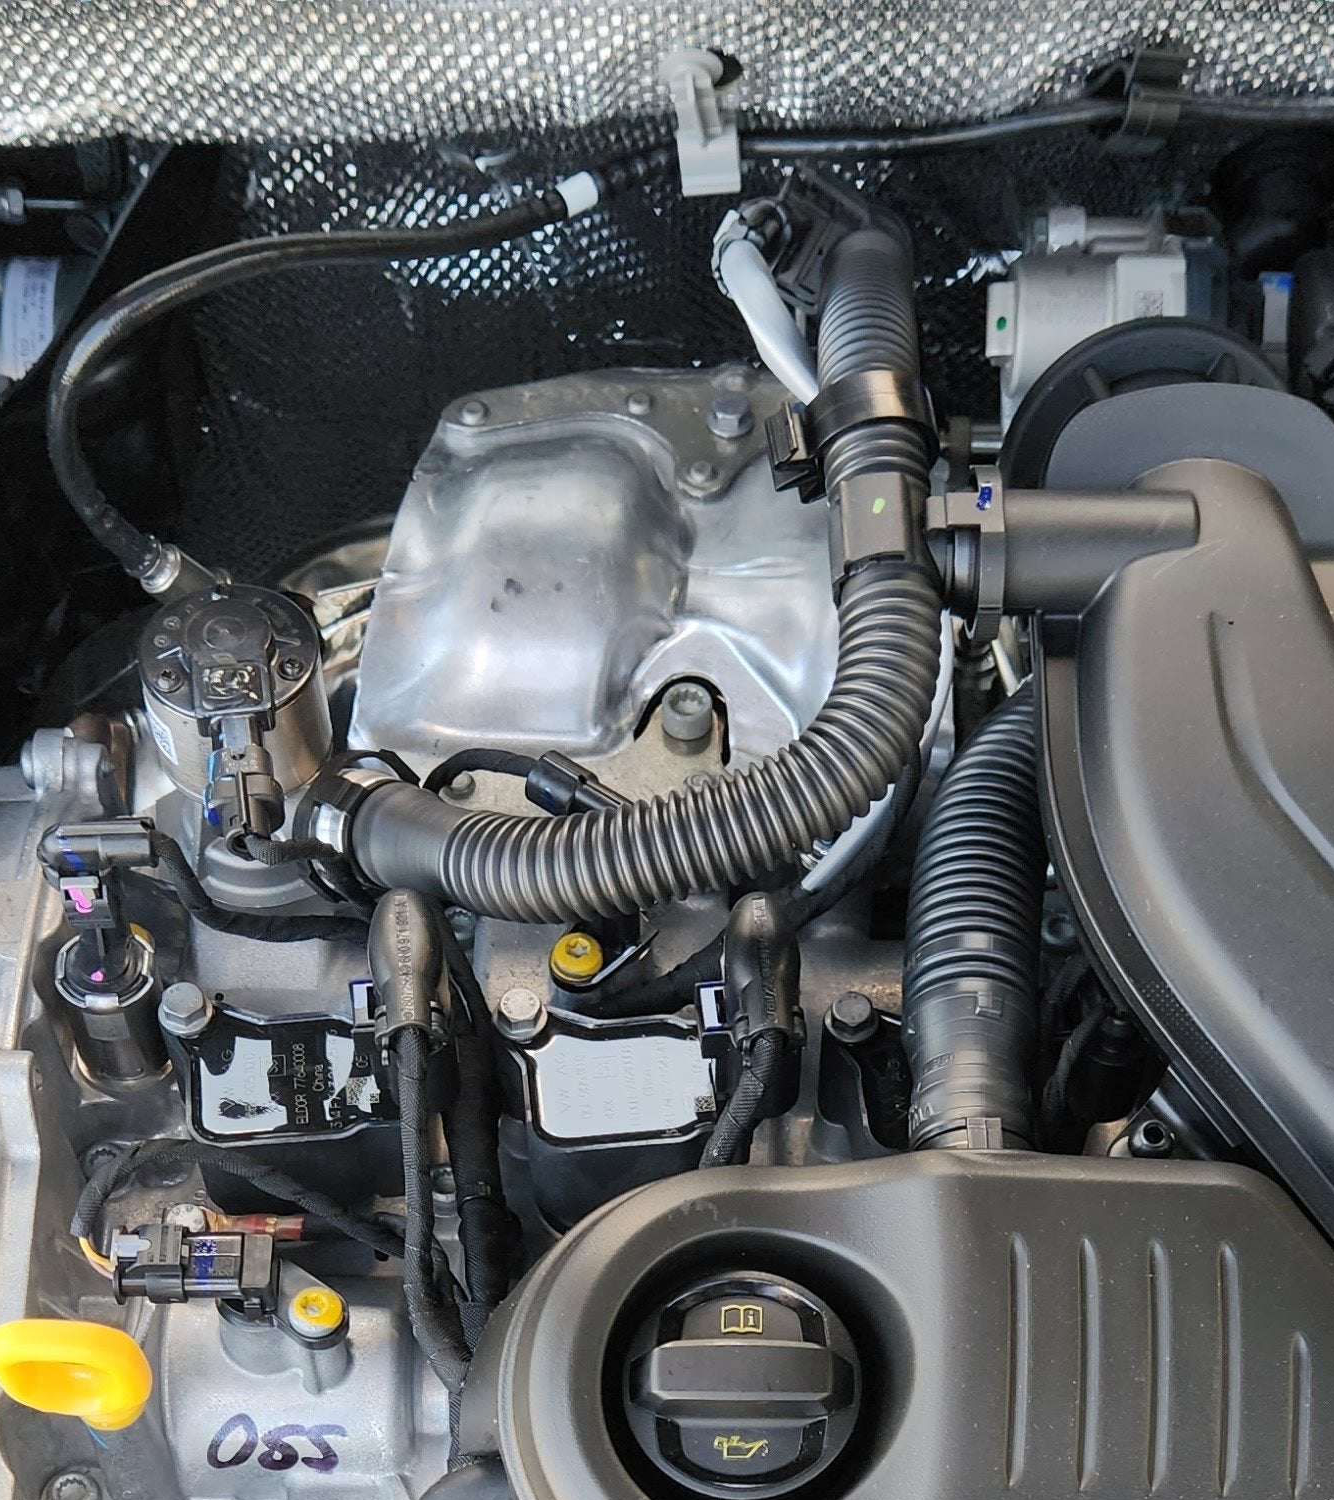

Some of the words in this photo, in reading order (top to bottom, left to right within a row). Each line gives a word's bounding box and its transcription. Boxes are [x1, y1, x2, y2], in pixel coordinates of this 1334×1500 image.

[292, 1042, 307, 1090] 77640008
[312, 1063, 325, 1092] China
[295, 1093, 309, 1125] ELDOR
